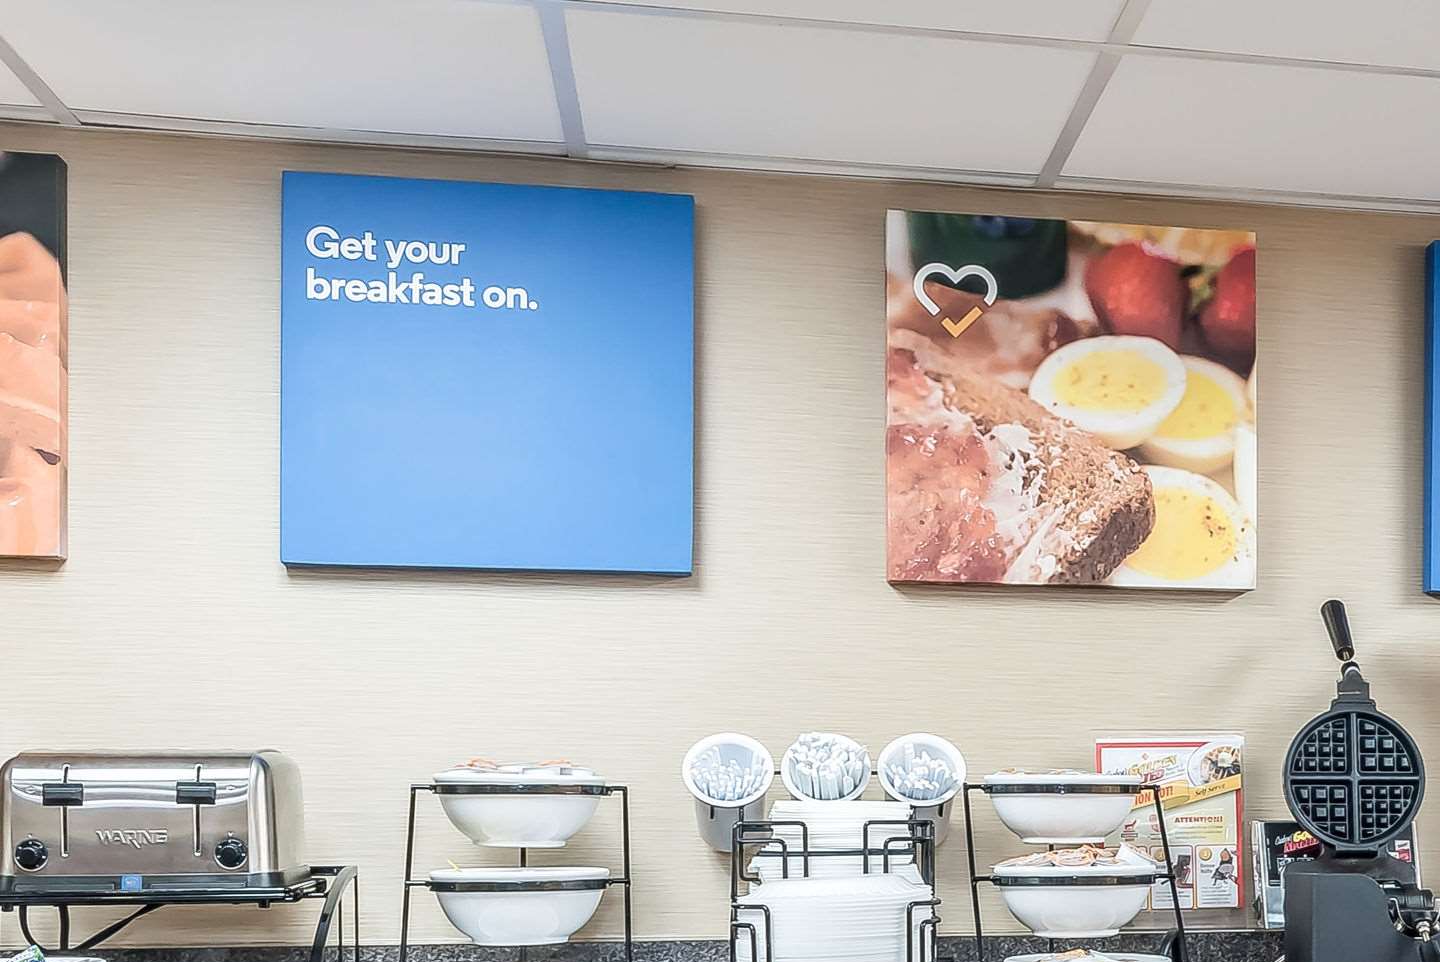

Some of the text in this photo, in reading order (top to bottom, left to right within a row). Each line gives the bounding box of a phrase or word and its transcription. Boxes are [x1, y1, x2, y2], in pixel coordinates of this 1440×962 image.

[305, 225, 466, 269] Get your
[306, 267, 538, 310] breakfast on.
[1174, 815, 1223, 823] ATTENTION!
